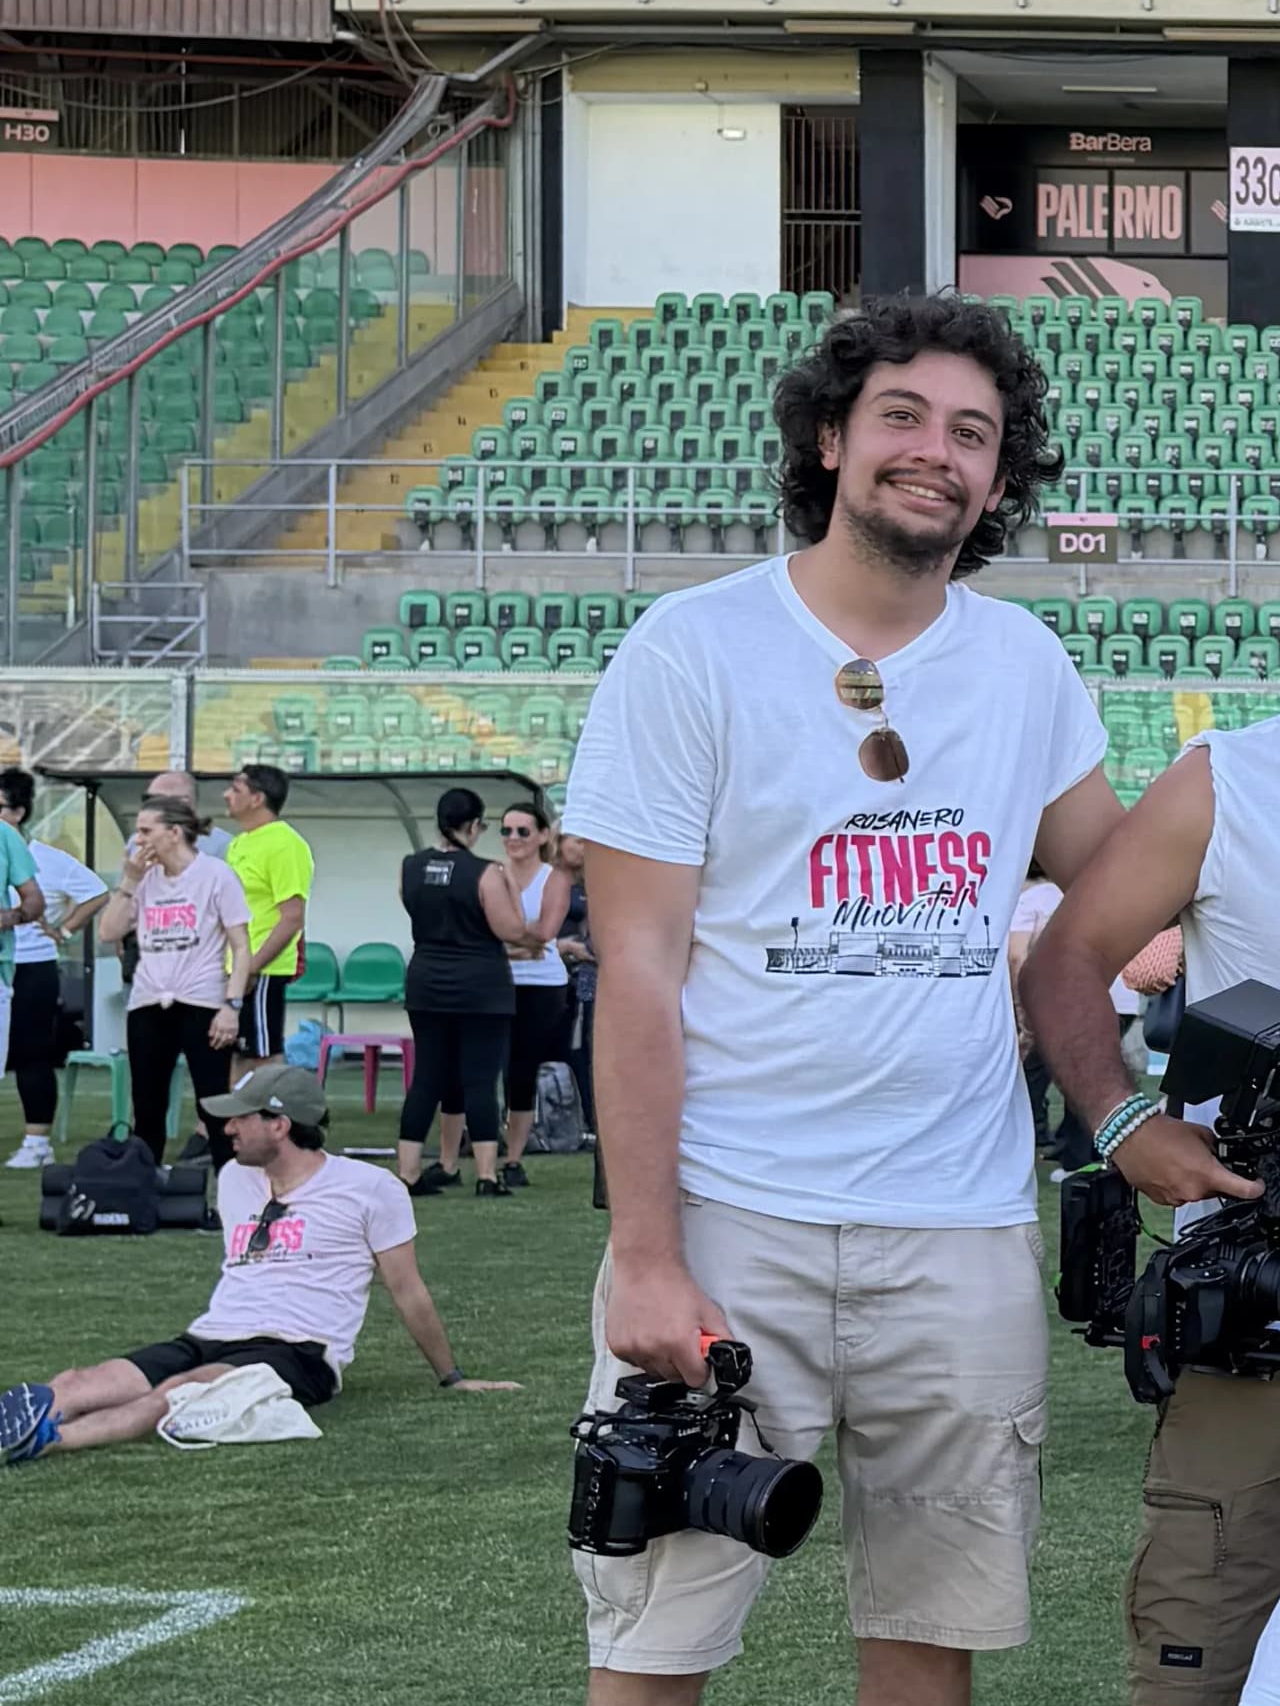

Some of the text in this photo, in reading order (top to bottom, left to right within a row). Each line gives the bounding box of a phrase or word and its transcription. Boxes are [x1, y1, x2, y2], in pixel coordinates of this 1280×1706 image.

[4, 123, 50, 142] H30
[1069, 132, 1151, 151] BarBera
[1037, 183, 1183, 240] PALERMO
[1060, 533, 1106, 553] D01
[845, 808, 965, 832] ROSANERO
[809, 831, 991, 910] FITNESS
